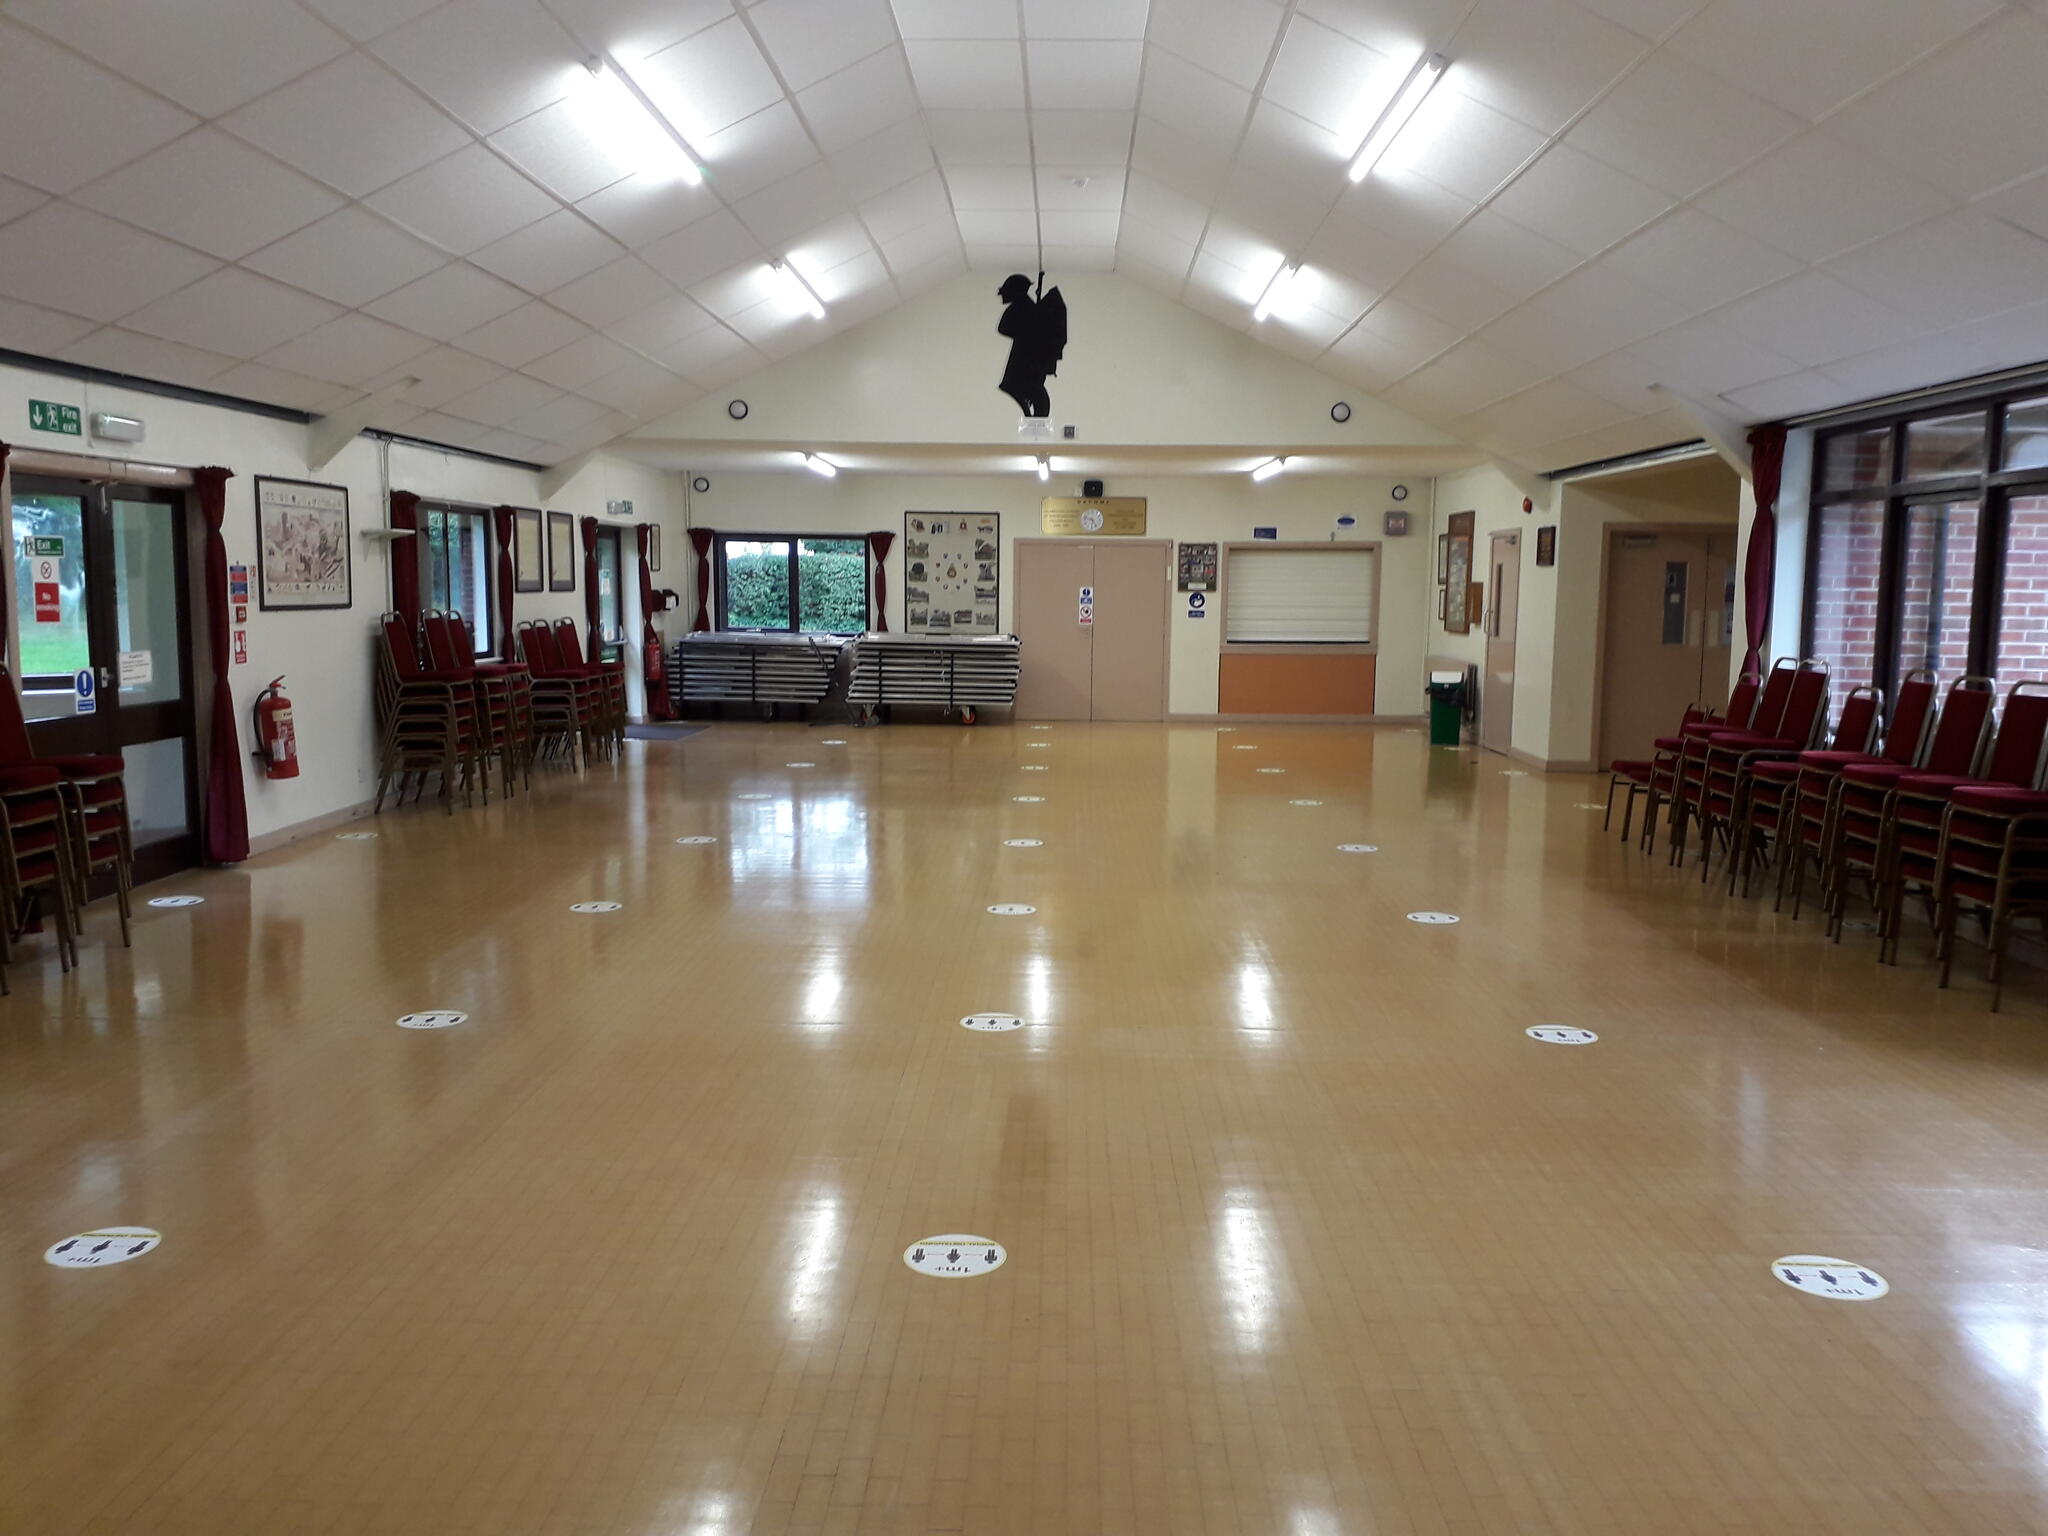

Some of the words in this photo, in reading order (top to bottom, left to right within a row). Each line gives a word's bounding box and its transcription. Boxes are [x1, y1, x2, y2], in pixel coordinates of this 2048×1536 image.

[61, 406, 78, 420] Fire
[62, 422, 78, 433] exit
[37, 540, 50, 550] Exit
[42, 591, 52, 601] No
